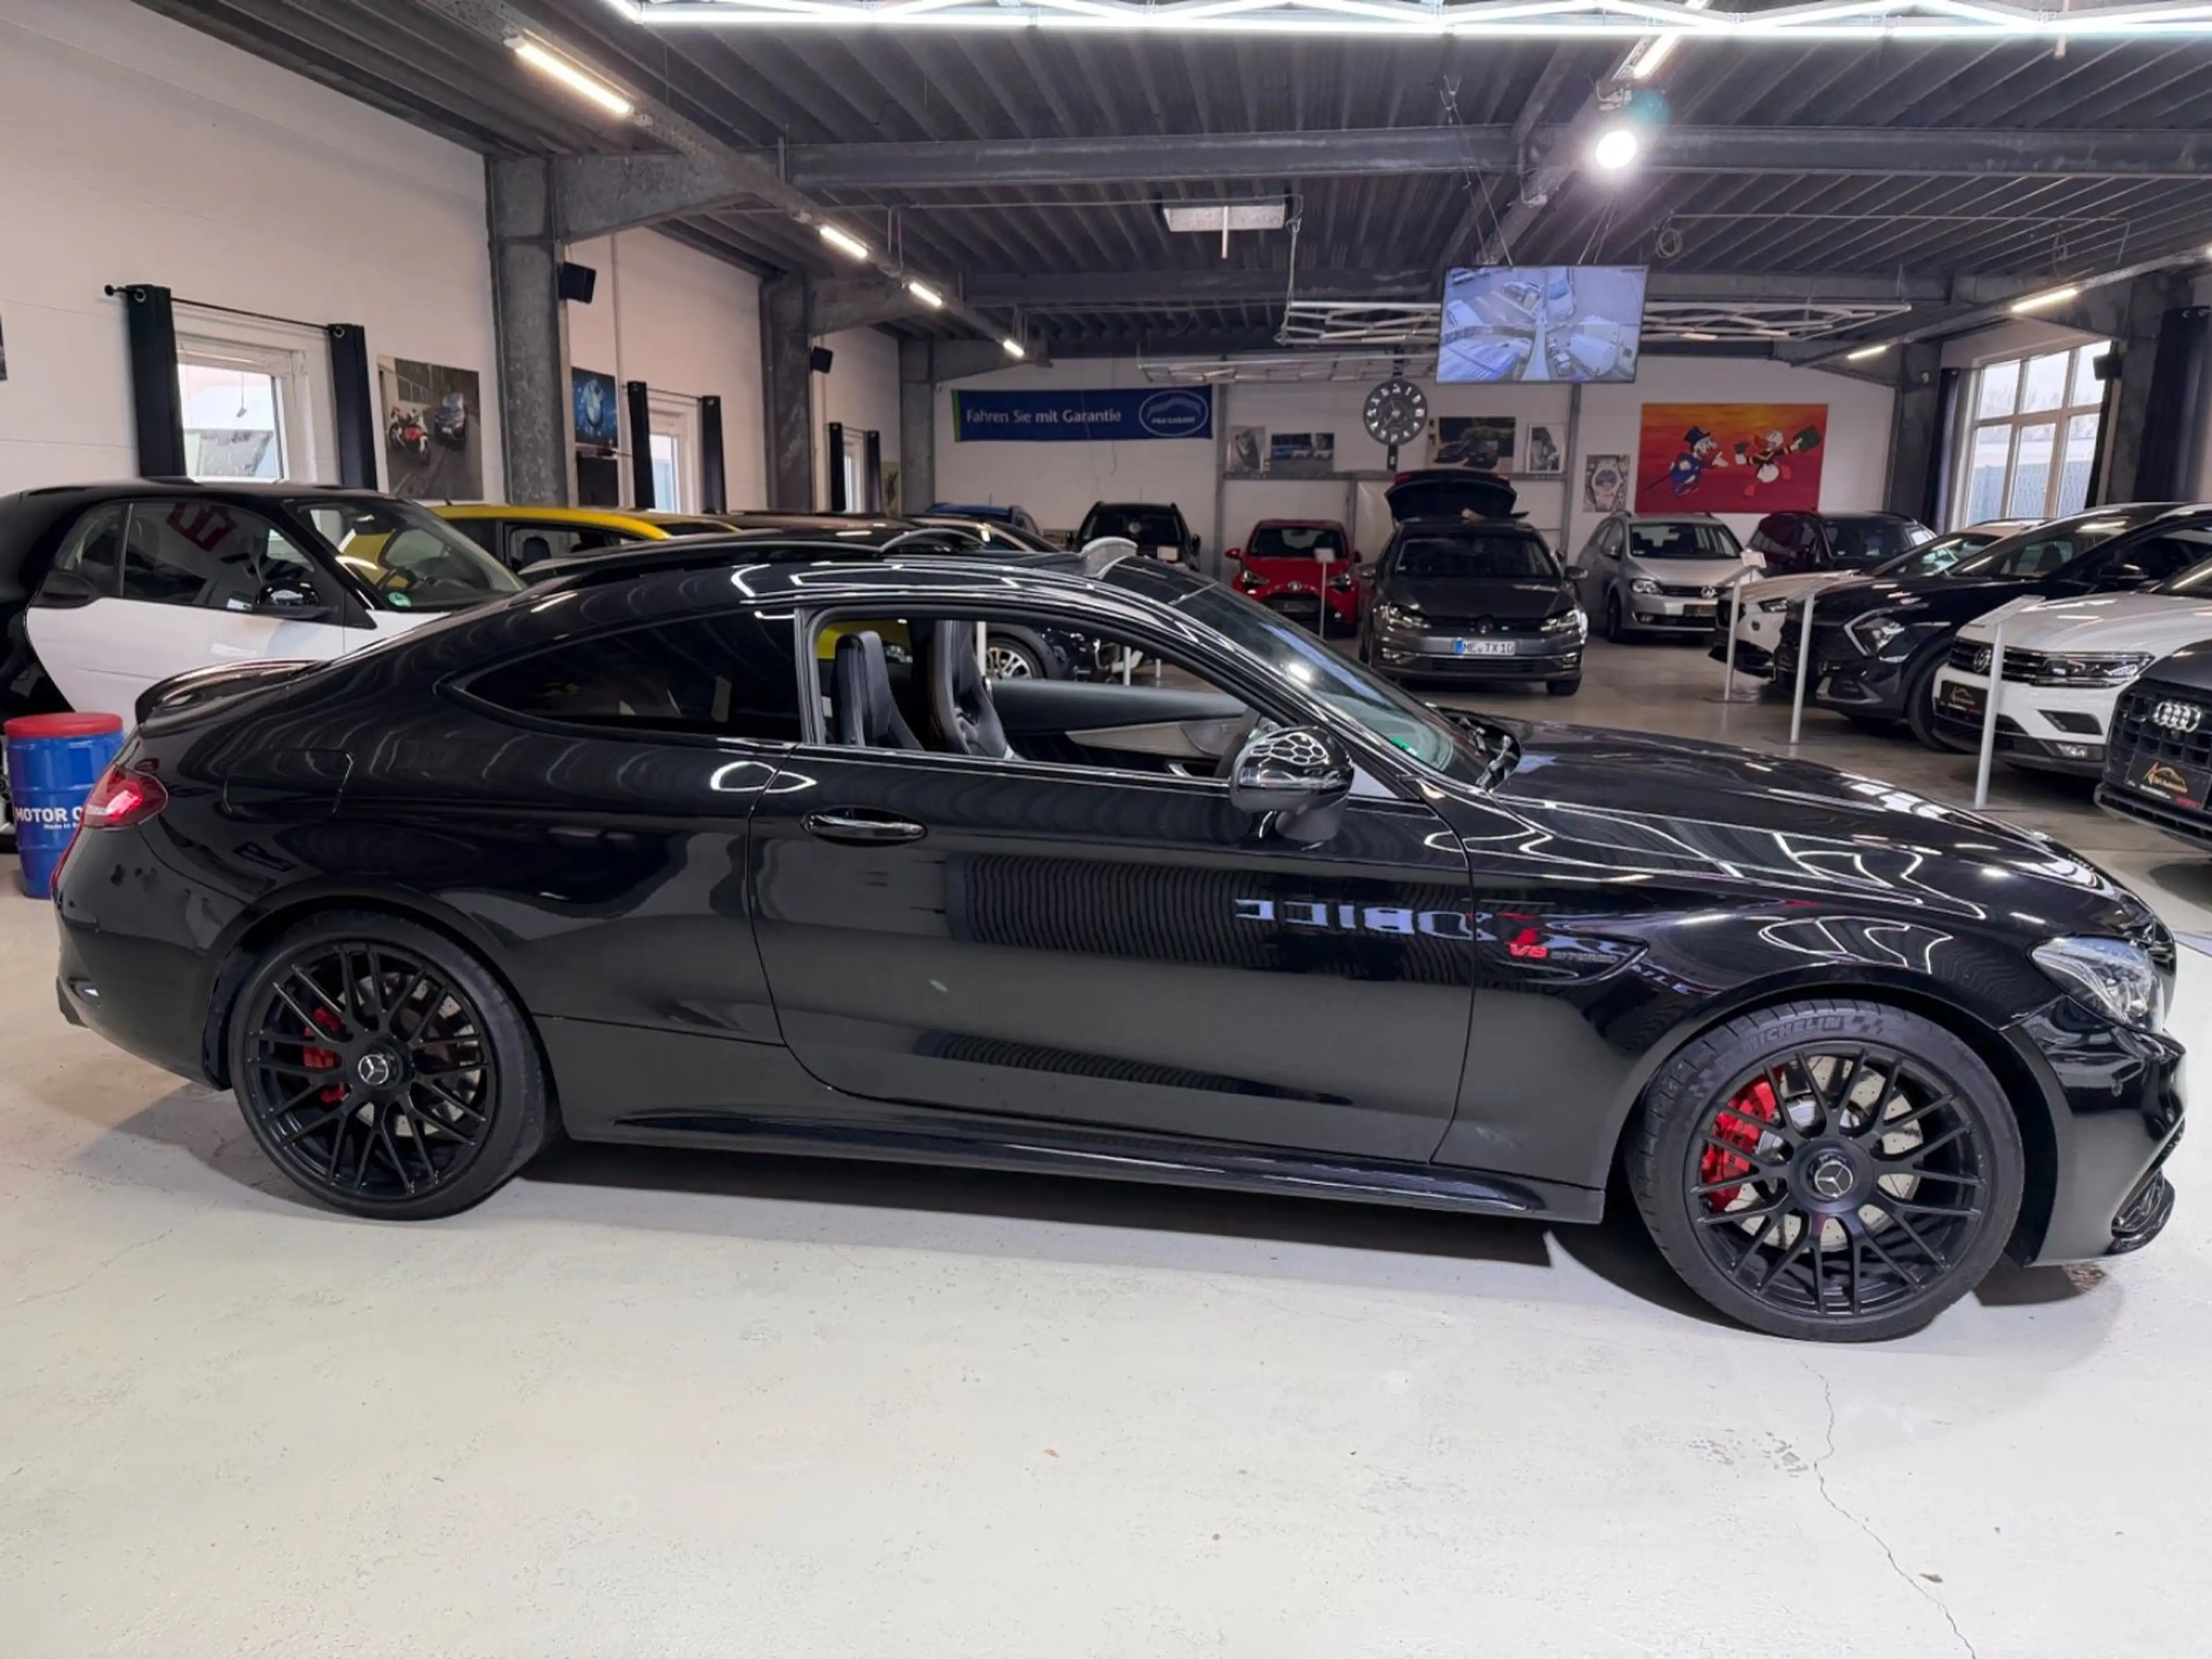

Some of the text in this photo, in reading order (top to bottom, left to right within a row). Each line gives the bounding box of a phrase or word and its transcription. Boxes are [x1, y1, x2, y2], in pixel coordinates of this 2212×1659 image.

[966, 408, 1122, 423] Fahren Sie mit Garantie
[15, 807, 68, 823] MOTOR
[1508, 942, 1548, 959] V8
[1747, 1016, 1842, 1052] MICHELIN
